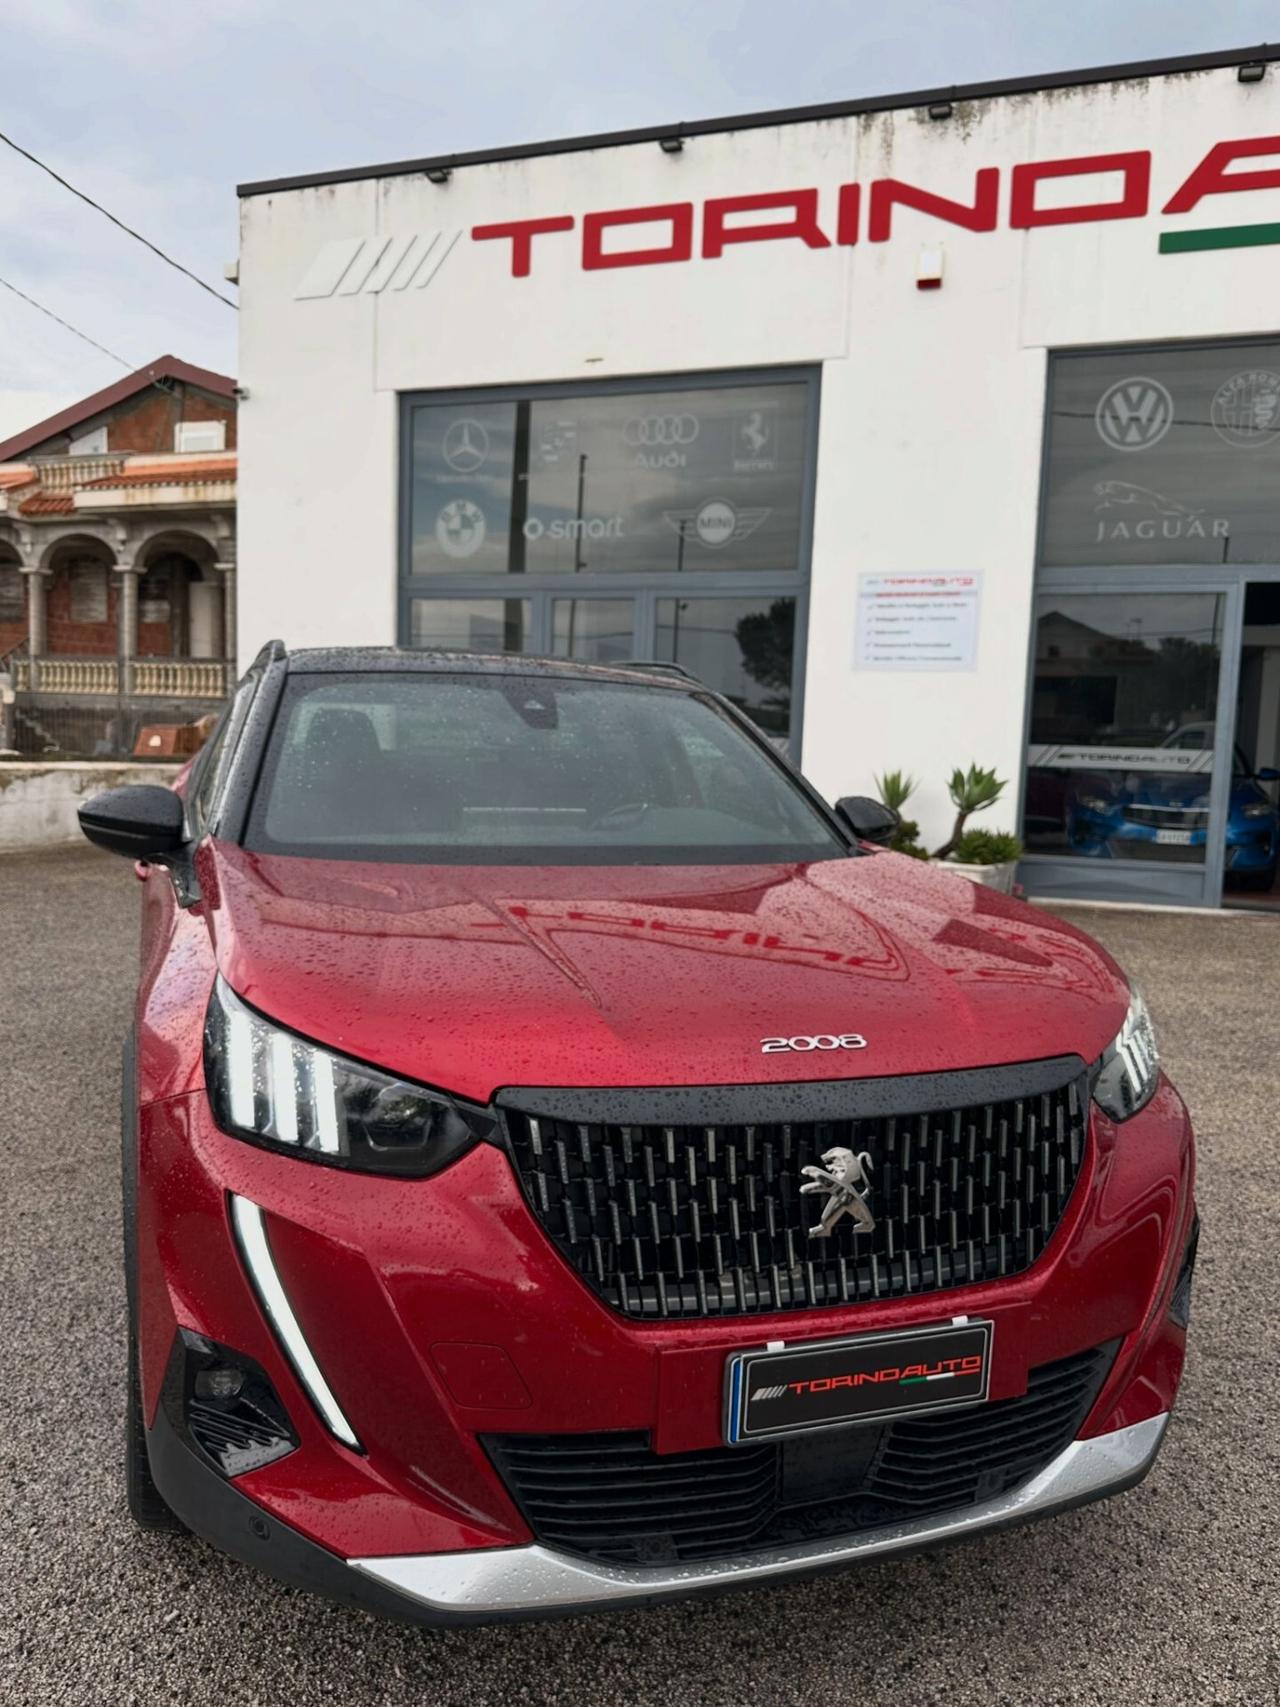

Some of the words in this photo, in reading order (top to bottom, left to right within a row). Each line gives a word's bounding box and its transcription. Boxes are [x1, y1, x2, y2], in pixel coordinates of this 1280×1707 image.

[550, 514, 624, 540] smart
[1096, 518, 1230, 543] JAGUAR
[760, 1034, 867, 1053] 2008
[788, 1355, 982, 1394] TORINOAUTO
